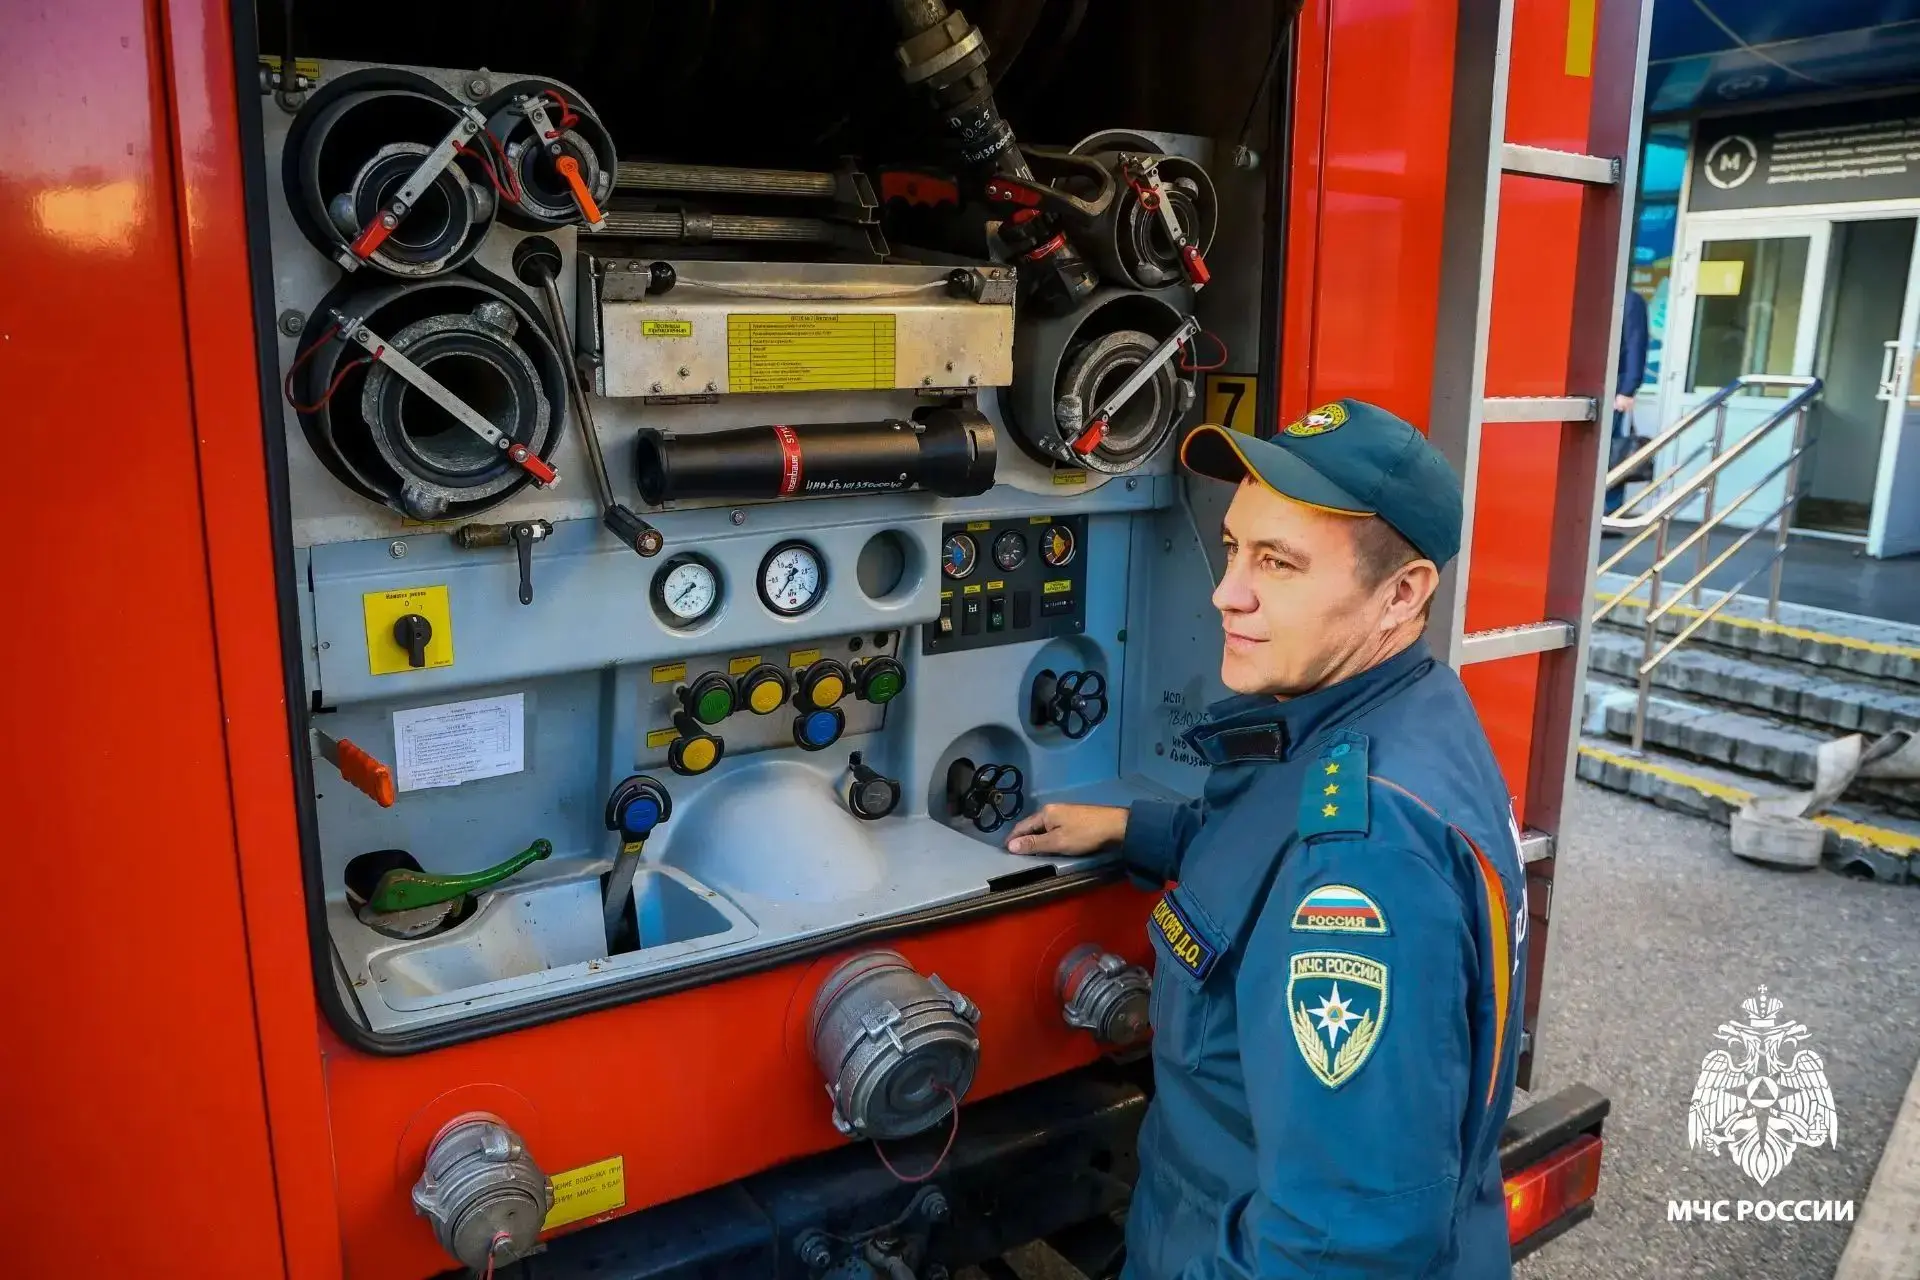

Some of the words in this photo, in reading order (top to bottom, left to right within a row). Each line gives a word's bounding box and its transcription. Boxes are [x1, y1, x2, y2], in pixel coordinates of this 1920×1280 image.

[1217, 382, 1245, 428] 7
[786, 455, 799, 492] rosenbauer
[1308, 915, 1366, 928] РОССИЯ
[1297, 958, 1324, 974] МЧС
[1325, 958, 1381, 982] РОССИИ
